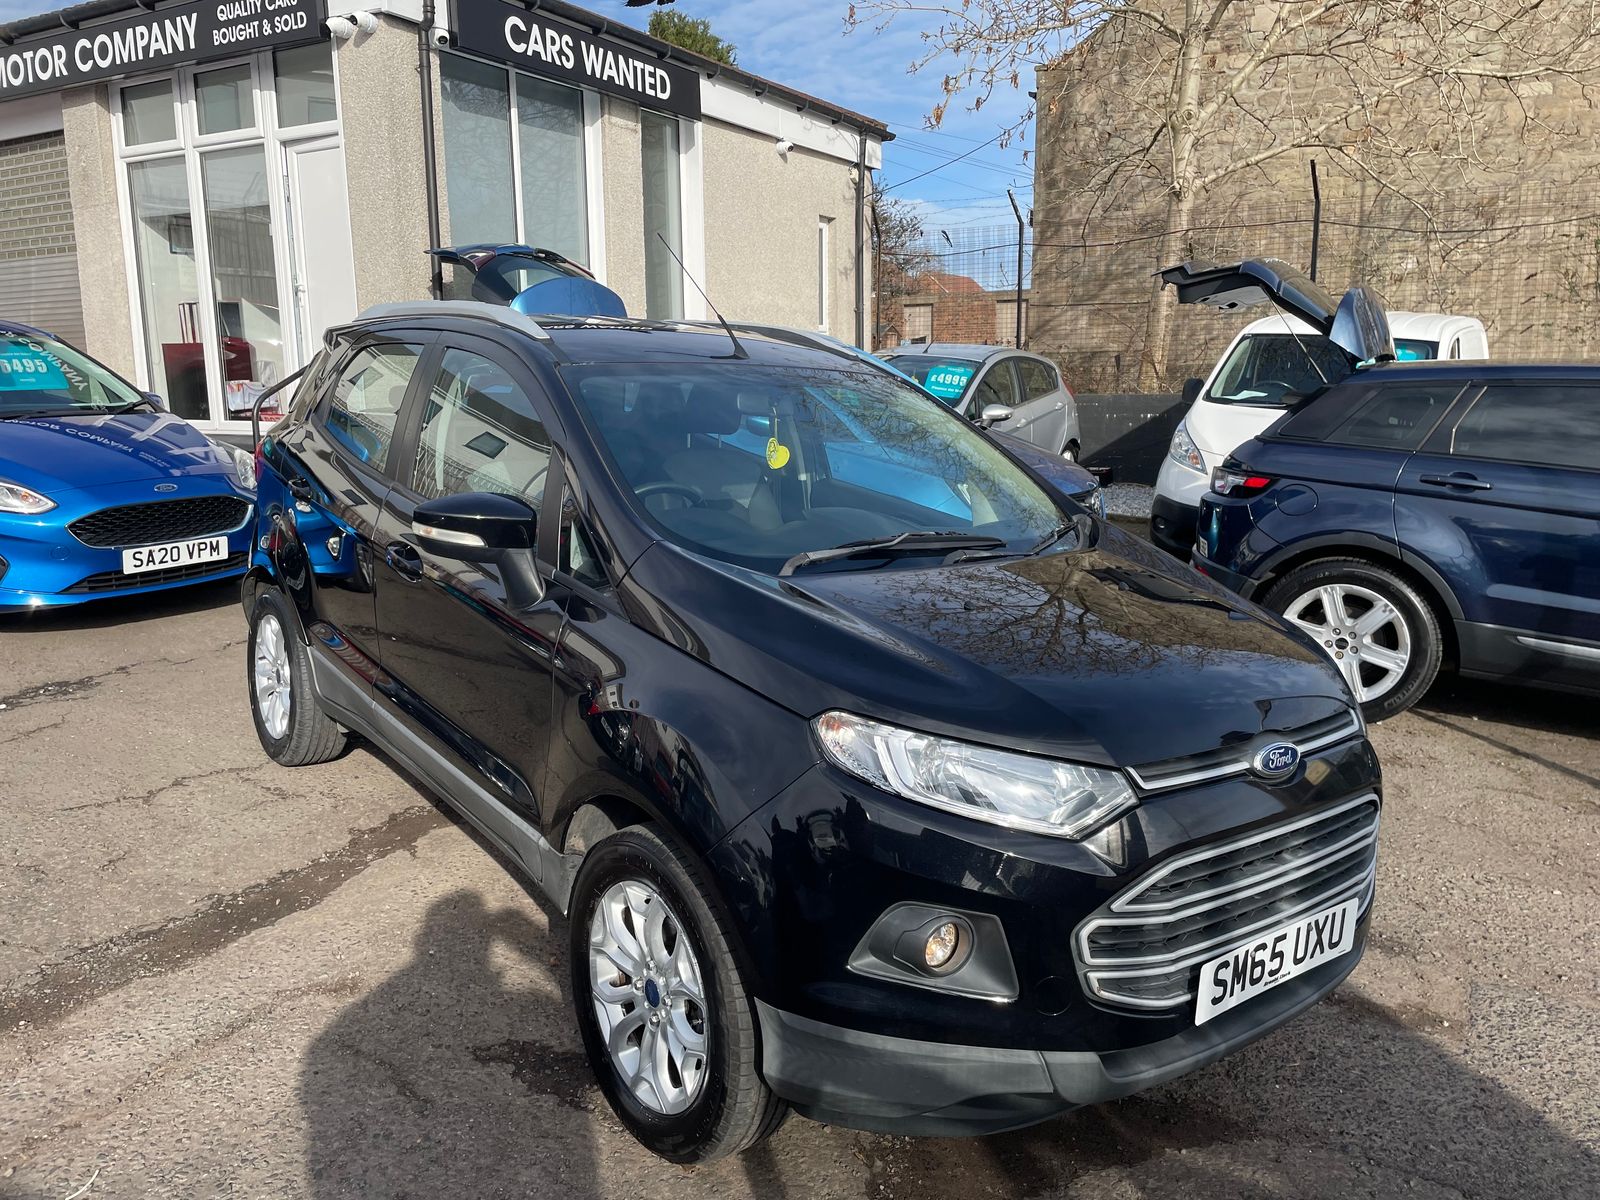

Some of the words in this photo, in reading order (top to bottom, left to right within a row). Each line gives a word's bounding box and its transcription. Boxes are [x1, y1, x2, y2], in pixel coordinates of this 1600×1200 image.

[216, 0, 261, 21] QUALITY
[74, 12, 198, 73] COMPANY
[212, 20, 259, 46] BOUGHT
[262, 18, 272, 36] &
[274, 11, 307, 33] SOLD
[504, 15, 574, 70] CARS
[580, 40, 671, 100] WANTED
[930, 373, 968, 387] £4995
[132, 545, 181, 569] SA20
[188, 540, 221, 561] VPM
[1268, 748, 1293, 769] Ford
[1210, 932, 1288, 1006] SM65
[1292, 908, 1347, 966] UXU
